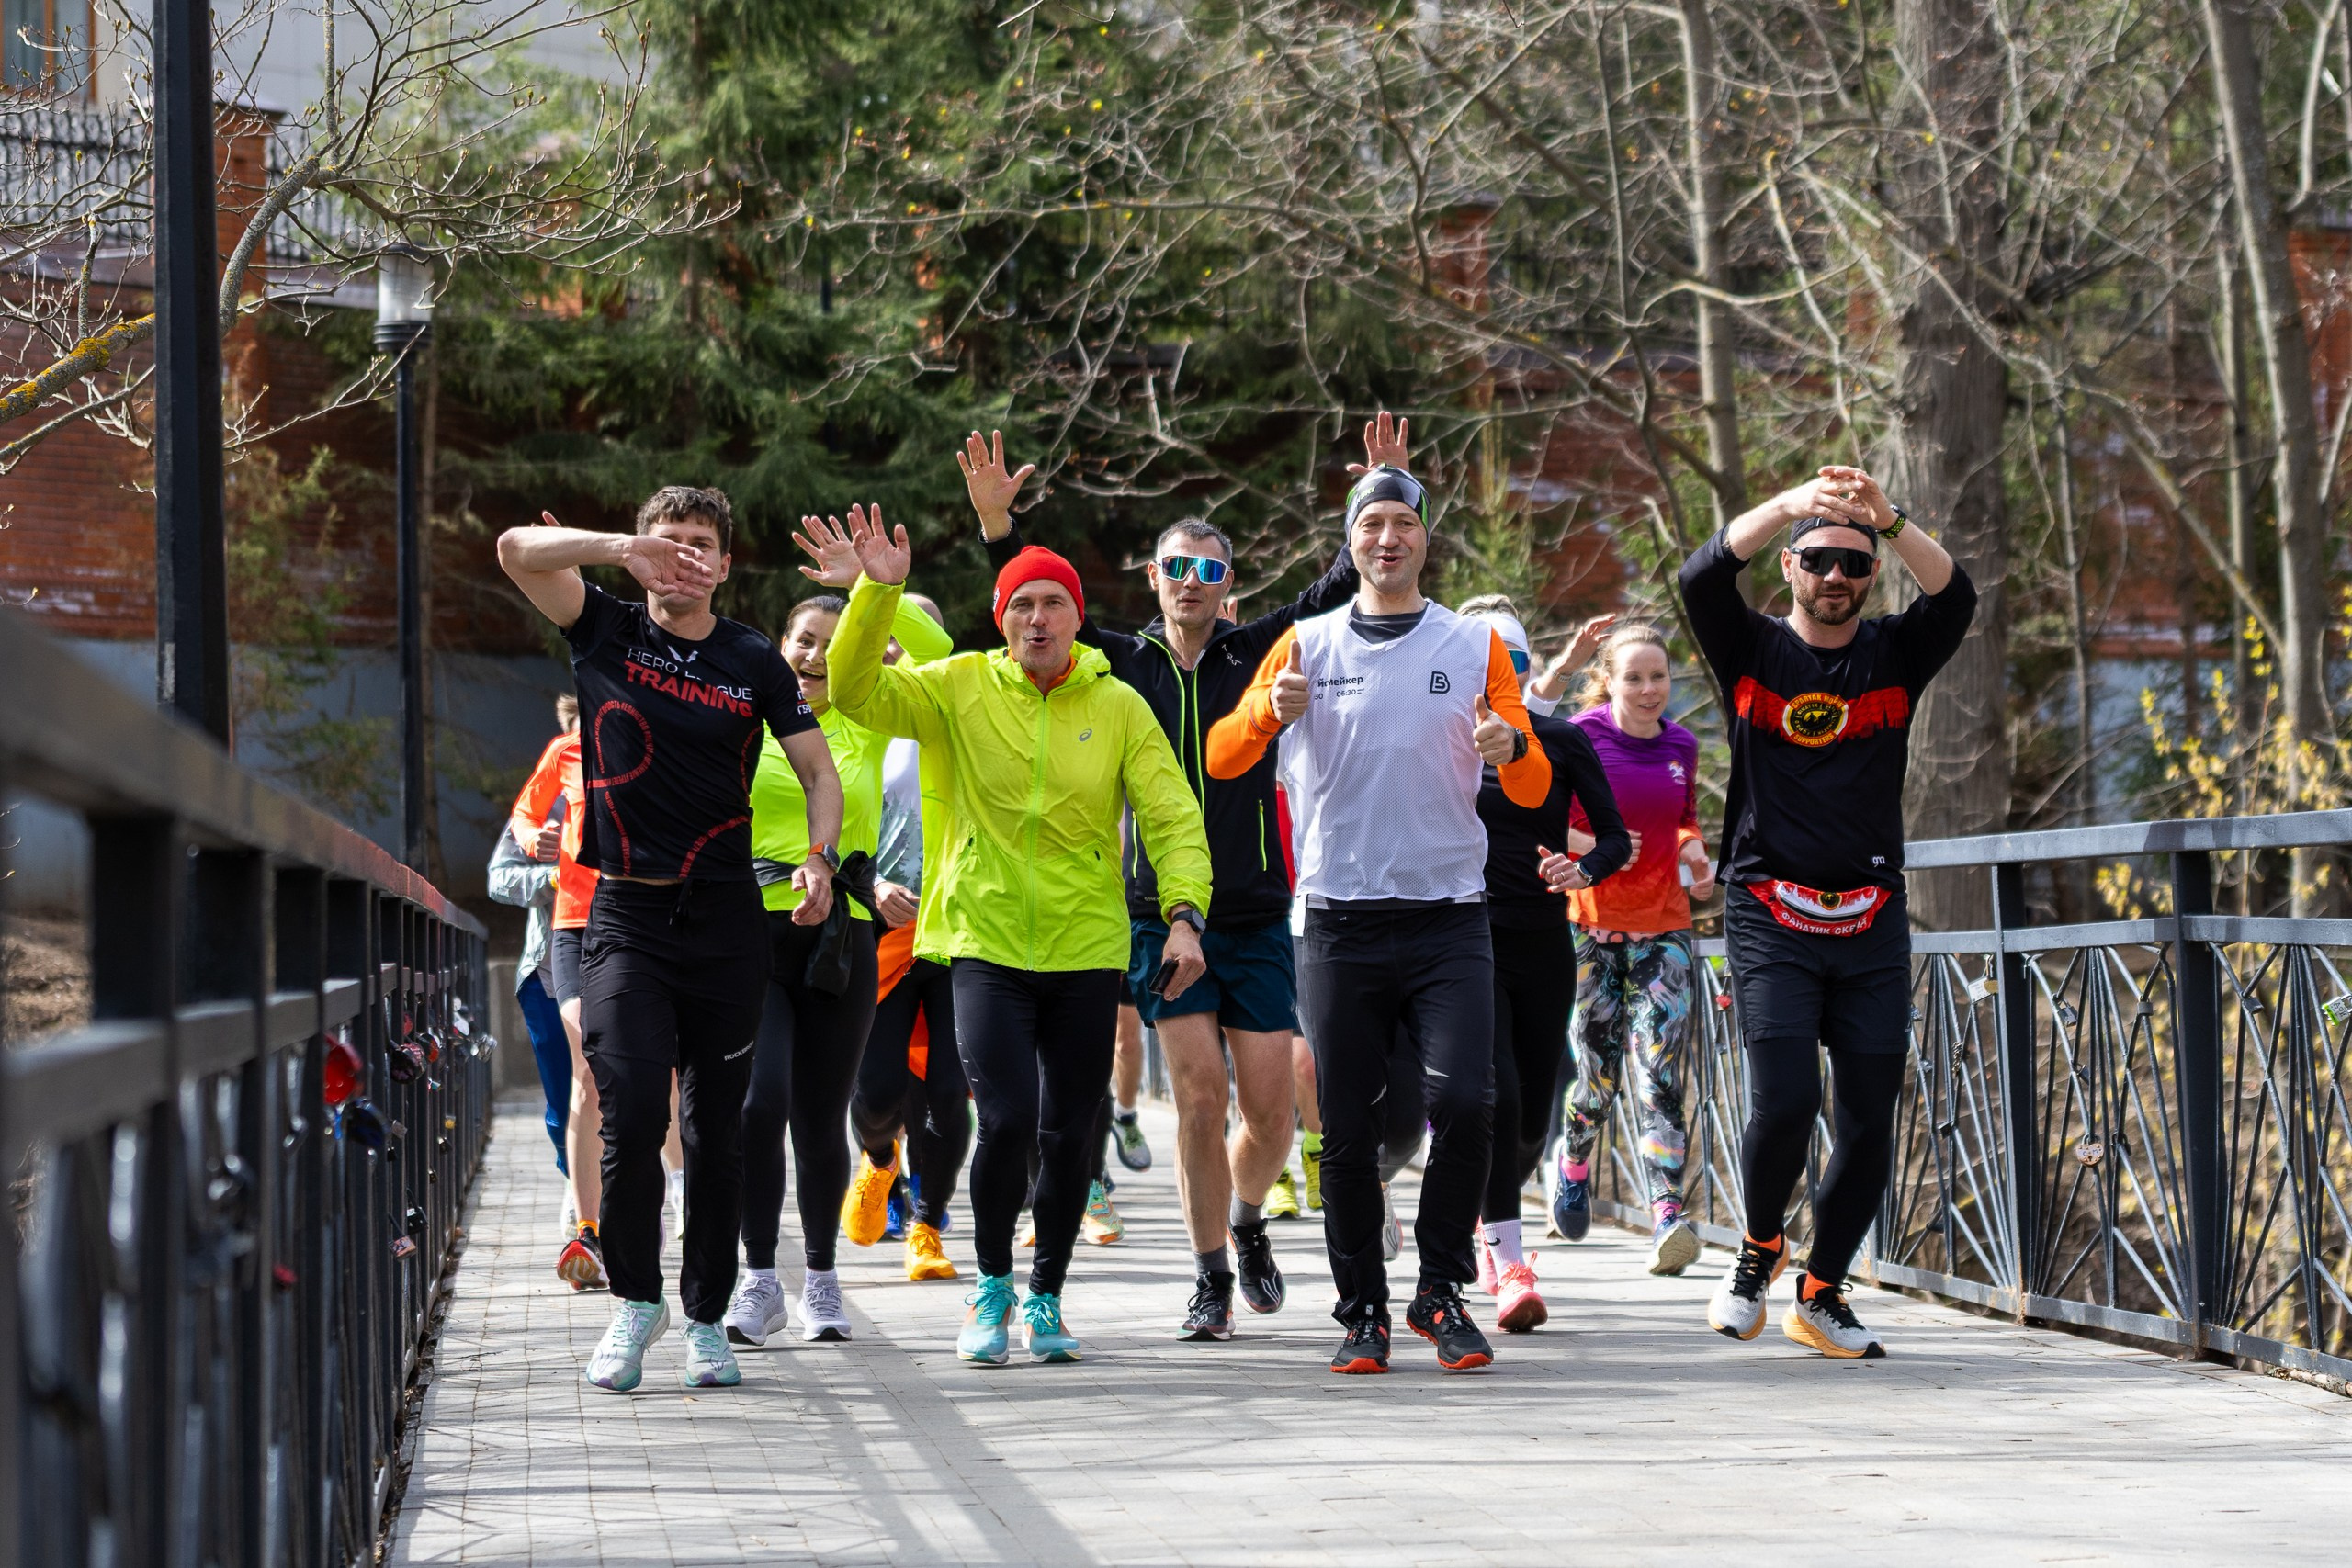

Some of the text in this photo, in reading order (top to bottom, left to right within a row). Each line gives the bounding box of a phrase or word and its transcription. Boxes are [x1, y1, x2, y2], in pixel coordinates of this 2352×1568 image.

[628, 648, 678, 674] HERO
[1336, 689, 1356, 698] 06:30
[1793, 732, 1835, 746] SUPPORTERS
[1781, 911, 1831, 934] ФАНАТИК
